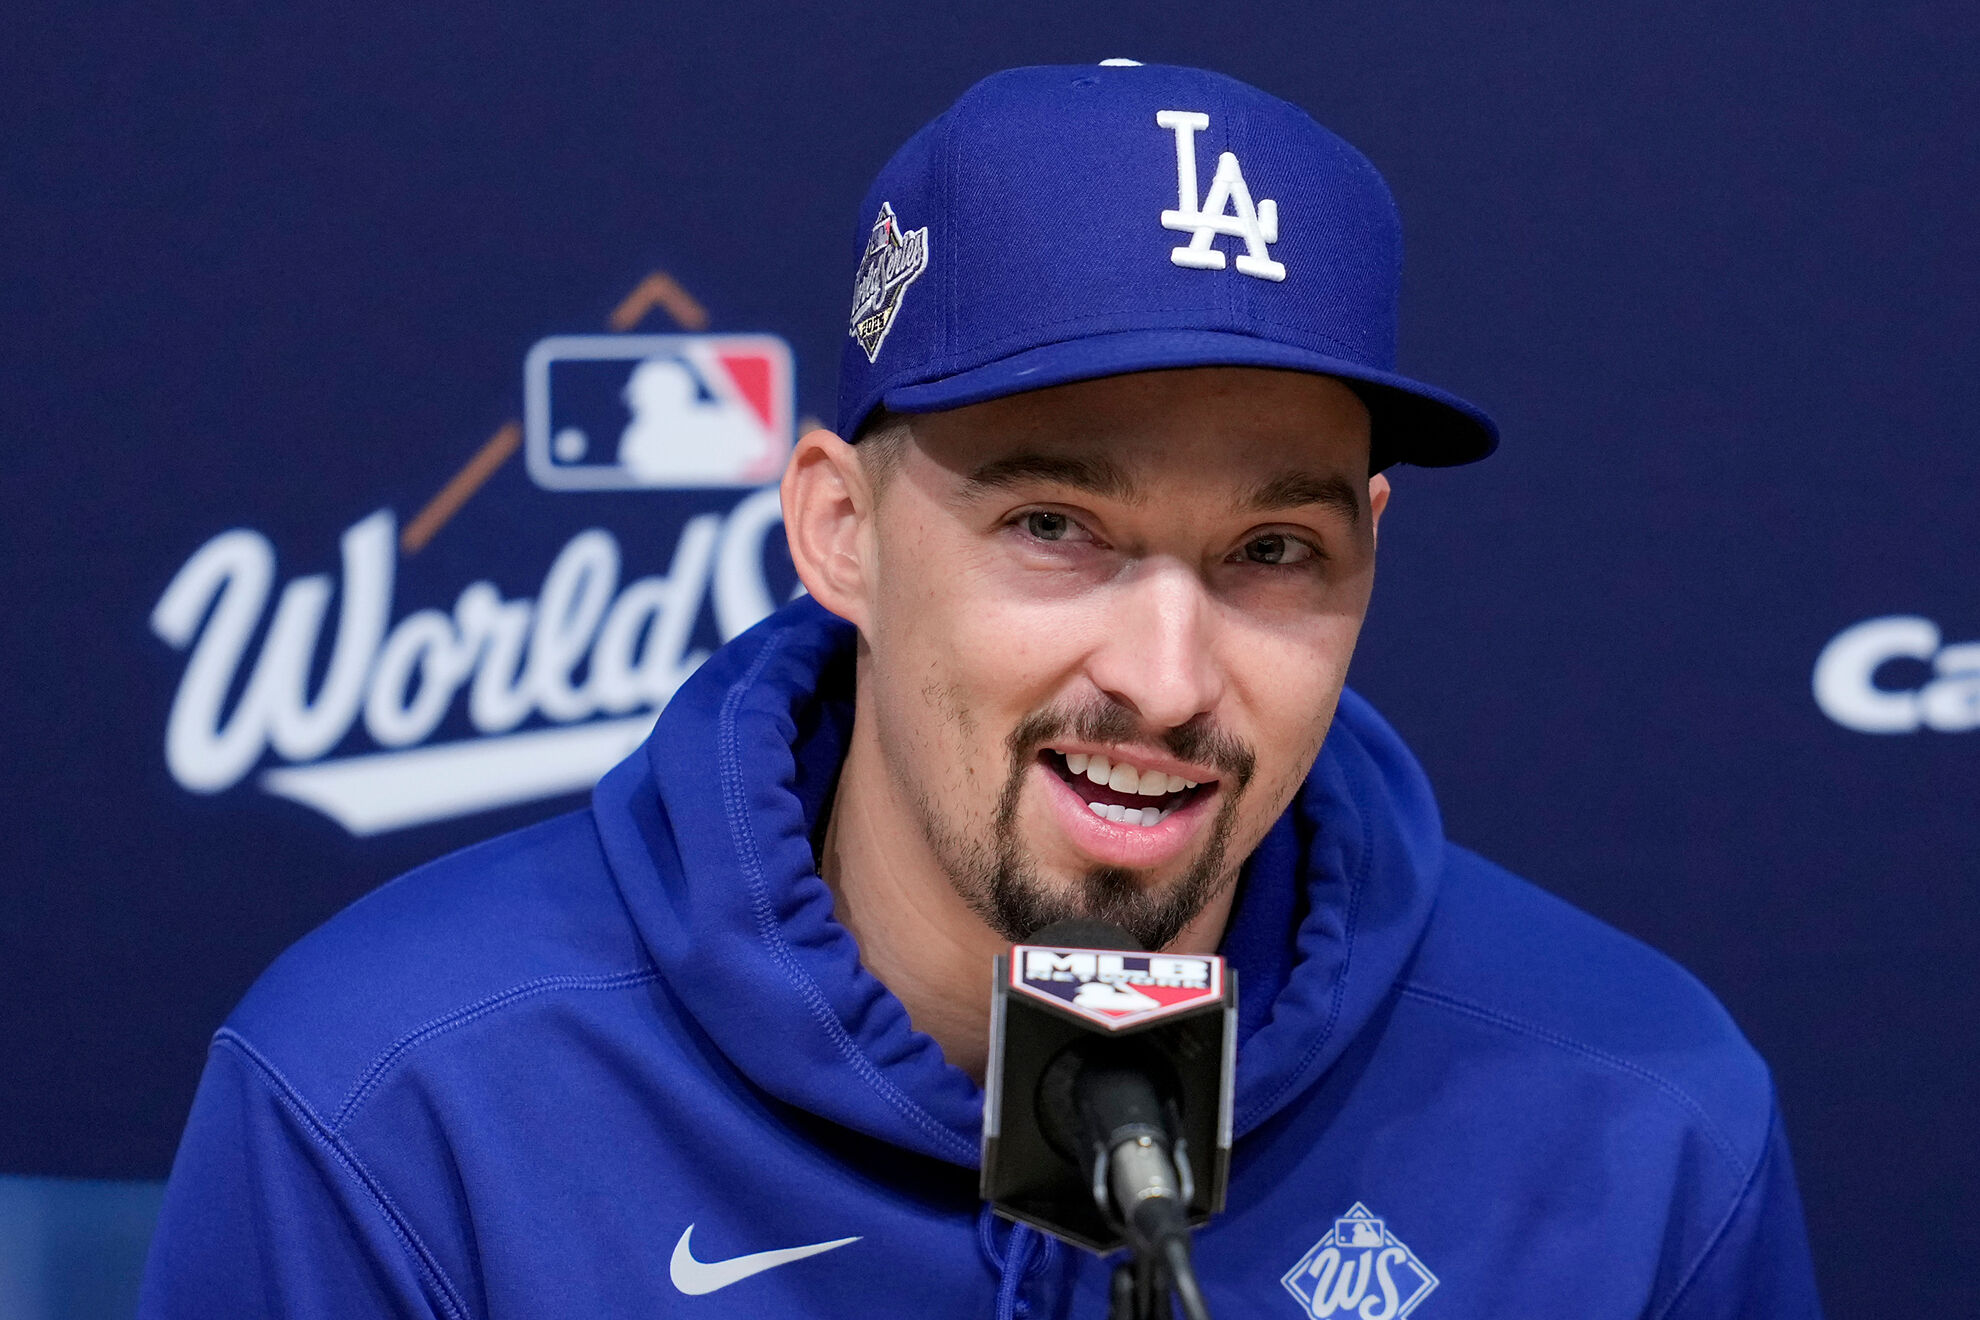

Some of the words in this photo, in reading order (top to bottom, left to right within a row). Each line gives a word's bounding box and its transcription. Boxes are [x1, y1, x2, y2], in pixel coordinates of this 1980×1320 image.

[1156, 110, 1286, 282] LA
[861, 312, 885, 337] 2025
[150, 508, 724, 794] World
[1026, 951, 1208, 981] MLB
[1308, 1247, 1407, 1320] WS
